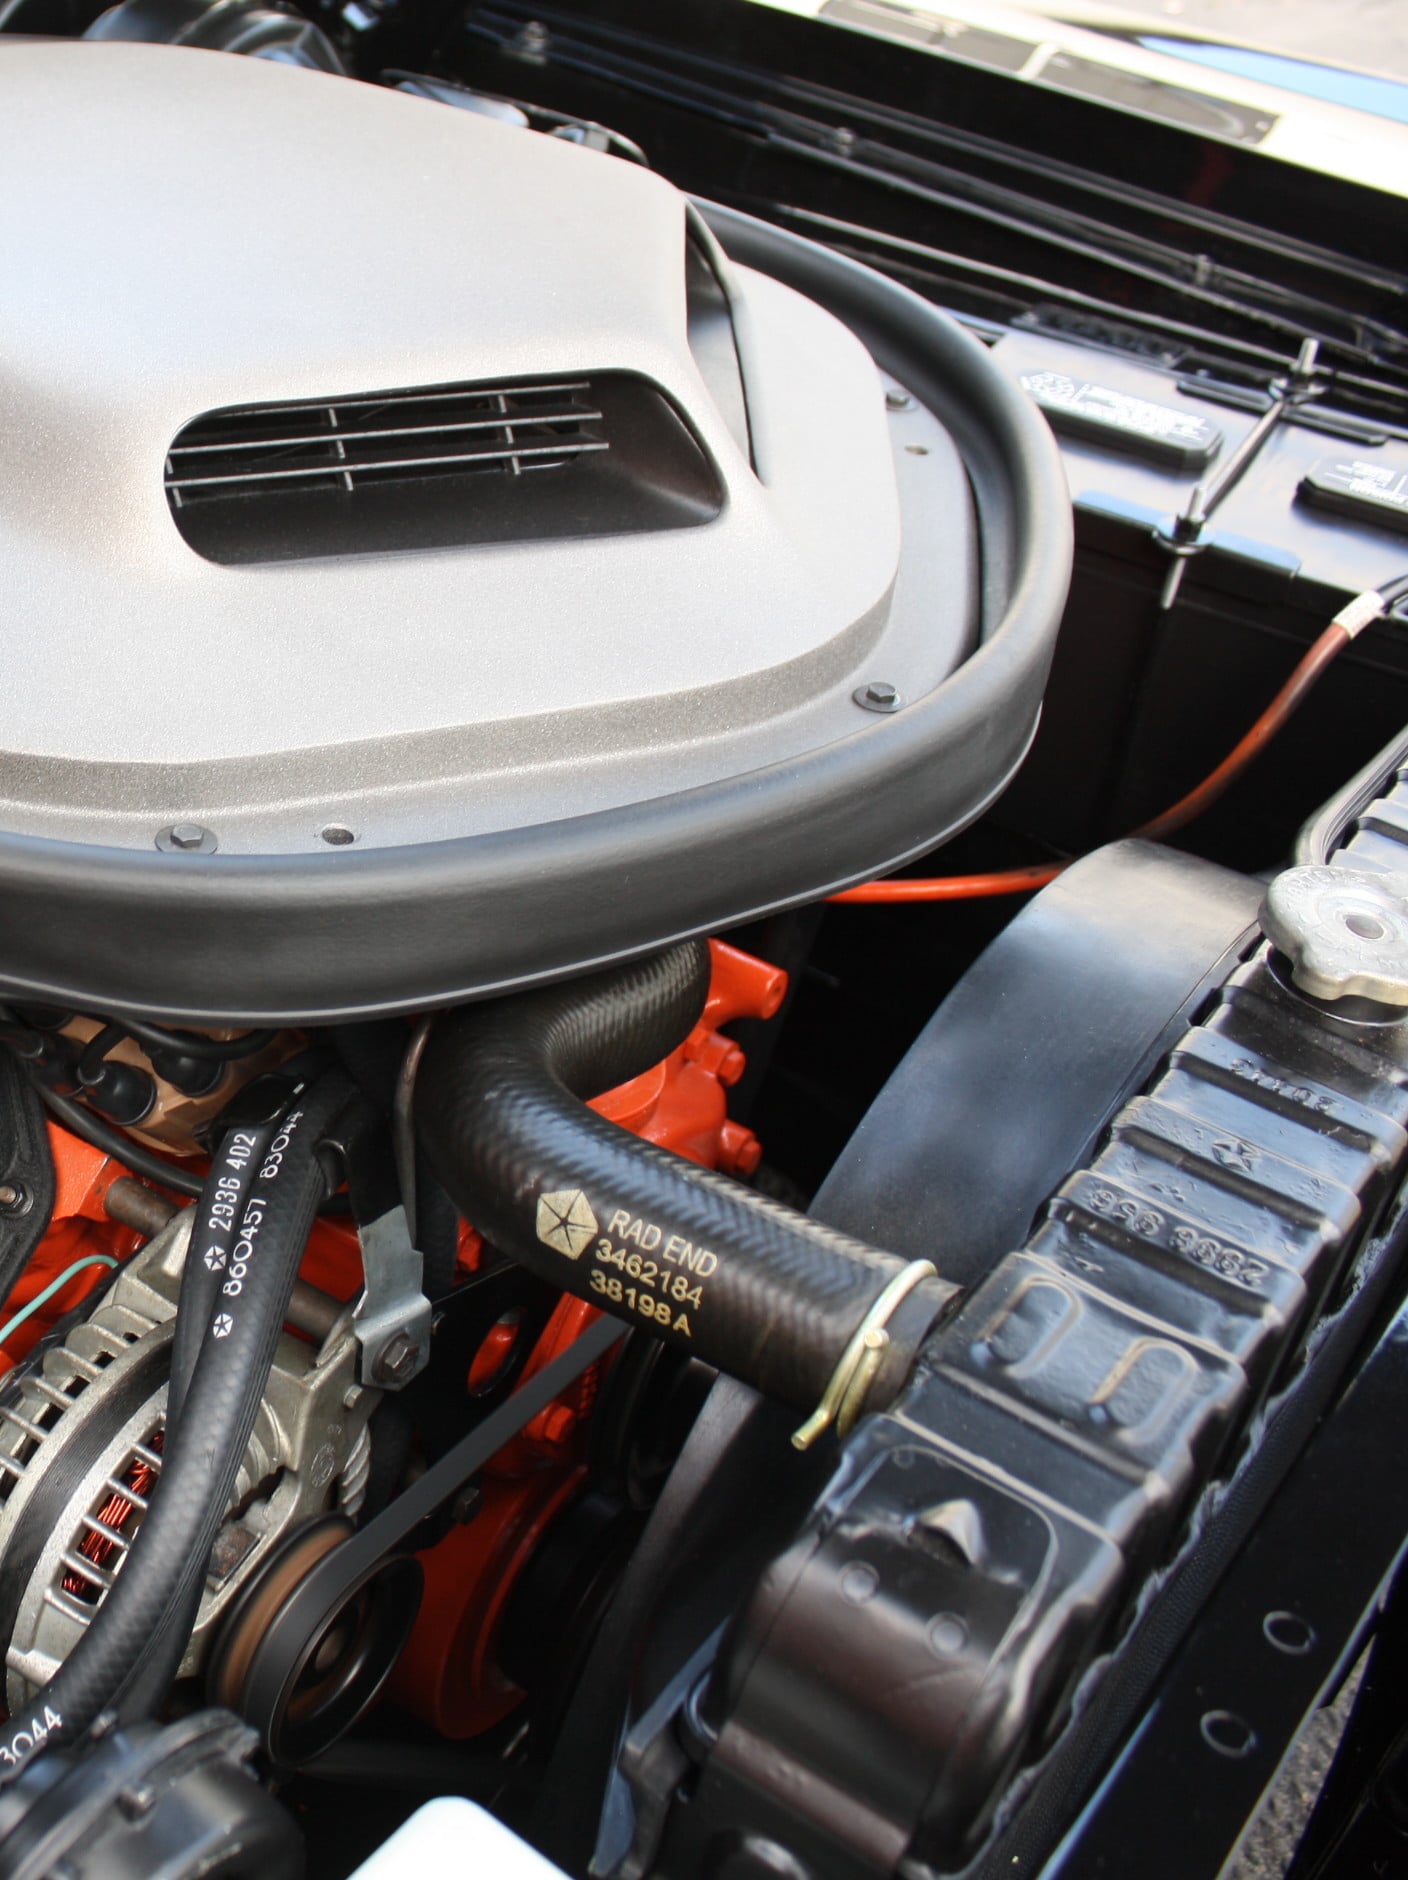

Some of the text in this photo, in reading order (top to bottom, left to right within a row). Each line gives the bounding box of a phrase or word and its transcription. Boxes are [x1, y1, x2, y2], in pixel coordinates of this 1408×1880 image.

[208, 1133, 256, 1232] 2936 402
[223, 1111, 303, 1296] 860457 83044
[595, 1238, 703, 1310] 3462184
[608, 1209, 718, 1278] RAD END
